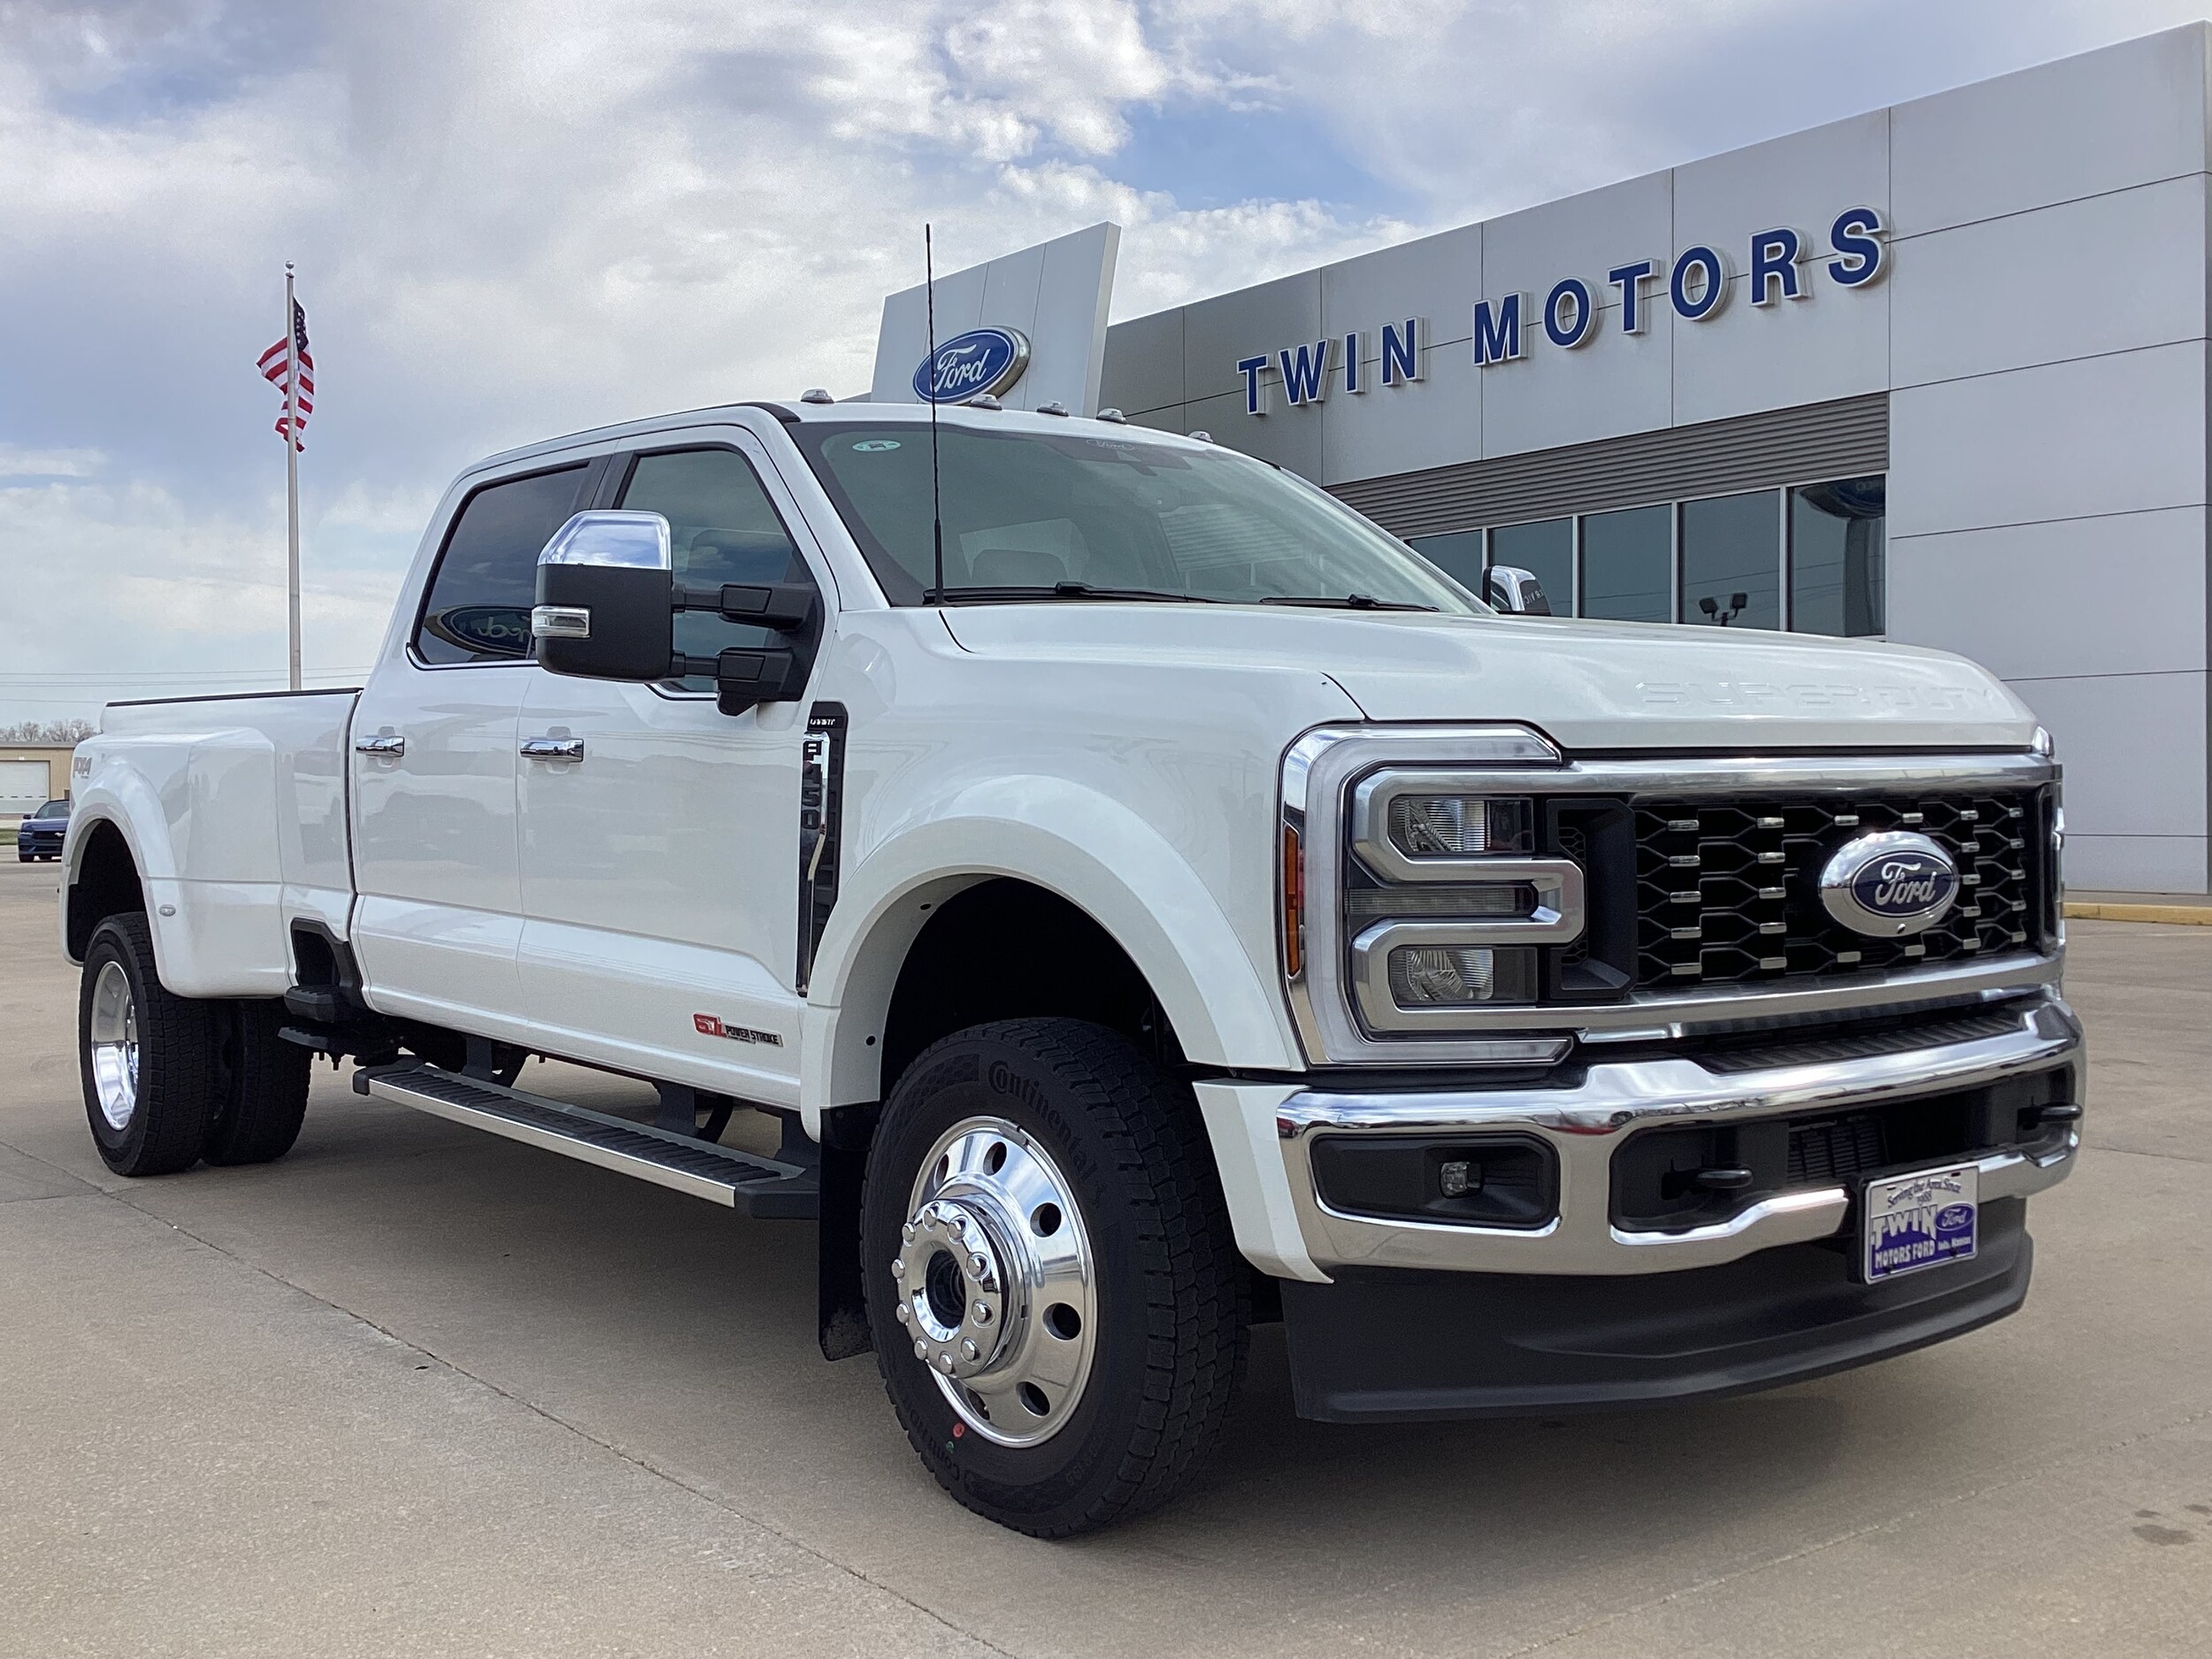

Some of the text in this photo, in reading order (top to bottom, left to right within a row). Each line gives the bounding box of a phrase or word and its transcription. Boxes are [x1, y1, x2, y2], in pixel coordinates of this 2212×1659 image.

[1236, 204, 1891, 416] TWIN MOTORS
[929, 343, 991, 393] Ford
[1875, 862, 1938, 906] Ford
[1870, 1203, 1939, 1250] TWIN
[1940, 1208, 1968, 1227] Ford
[1875, 1240, 1936, 1269] MOTORS FORD
